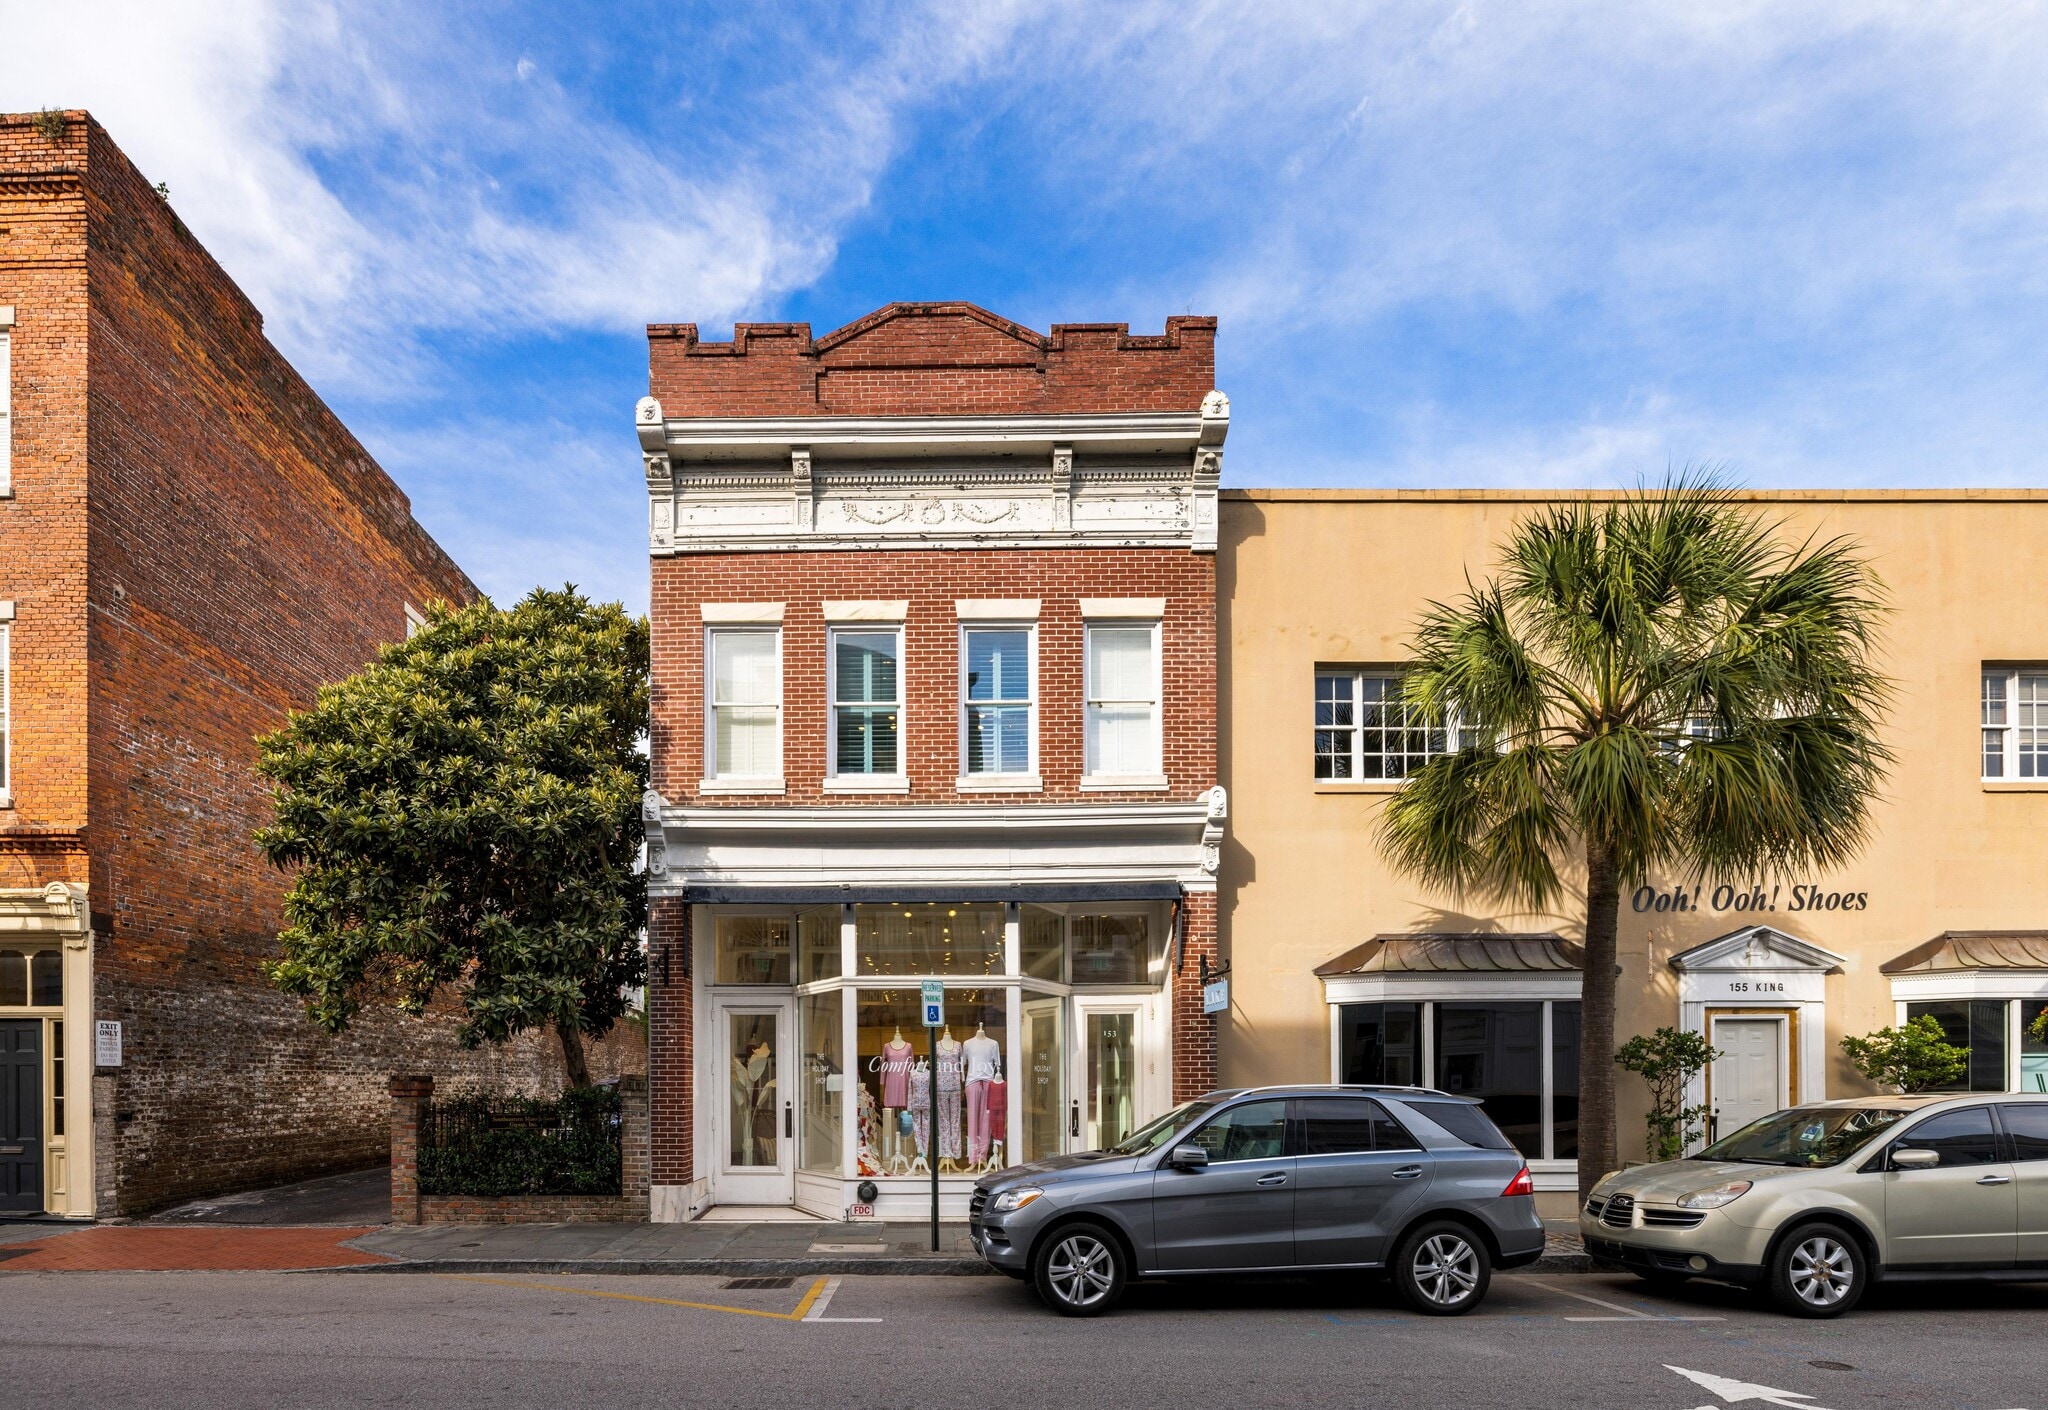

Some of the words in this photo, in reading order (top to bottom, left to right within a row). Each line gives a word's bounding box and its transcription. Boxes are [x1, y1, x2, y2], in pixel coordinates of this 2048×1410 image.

[1632, 885, 1701, 913] Ooh!
[1712, 885, 1780, 912] Ooh!
[1788, 884, 1869, 912] Shoes
[1729, 982, 1748, 992] 155
[1755, 982, 1784, 992] KING
[1103, 1030, 1117, 1038] 153
[868, 1056, 929, 1076] Comfort
[936, 1056, 964, 1073] and
[854, 1206, 870, 1214] FDC
